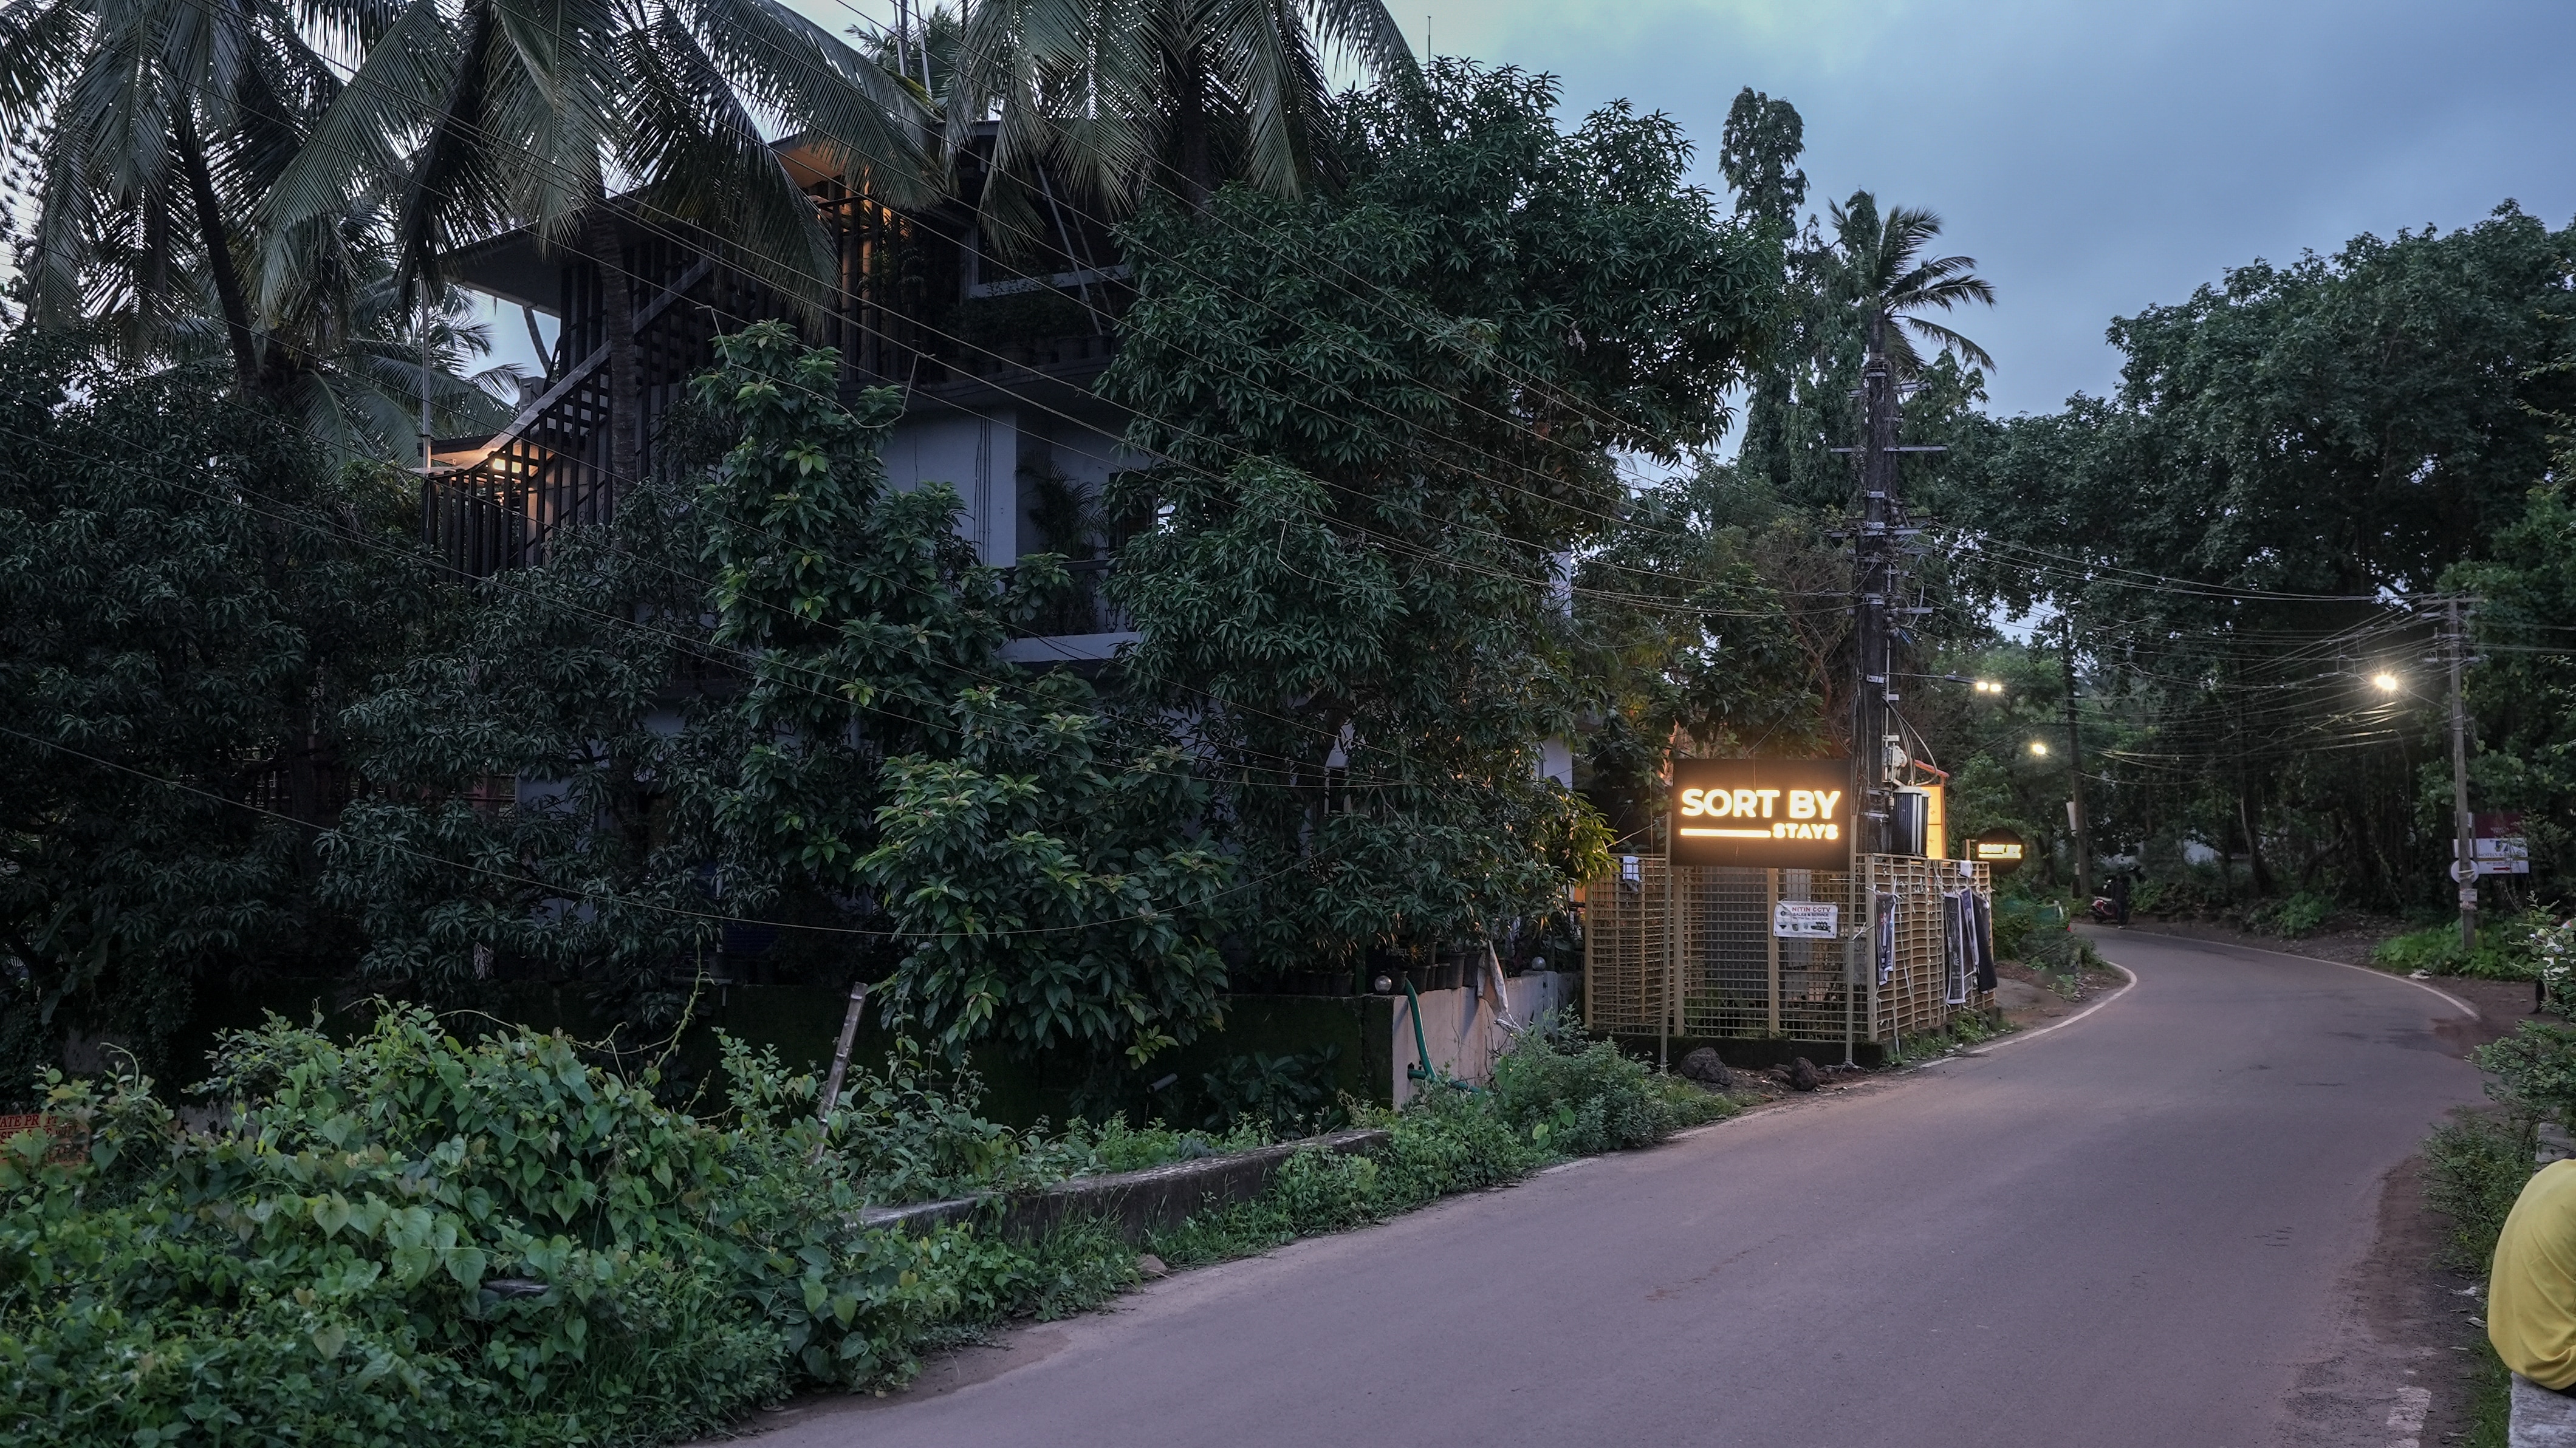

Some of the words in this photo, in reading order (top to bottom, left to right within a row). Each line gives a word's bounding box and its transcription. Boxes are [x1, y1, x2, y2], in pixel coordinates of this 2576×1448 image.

[1681, 788, 1780, 818] SORT
[1789, 790, 1841, 819] BY
[1773, 823, 1838, 839] STAYS
[0, 1116, 22, 1127] ATE
